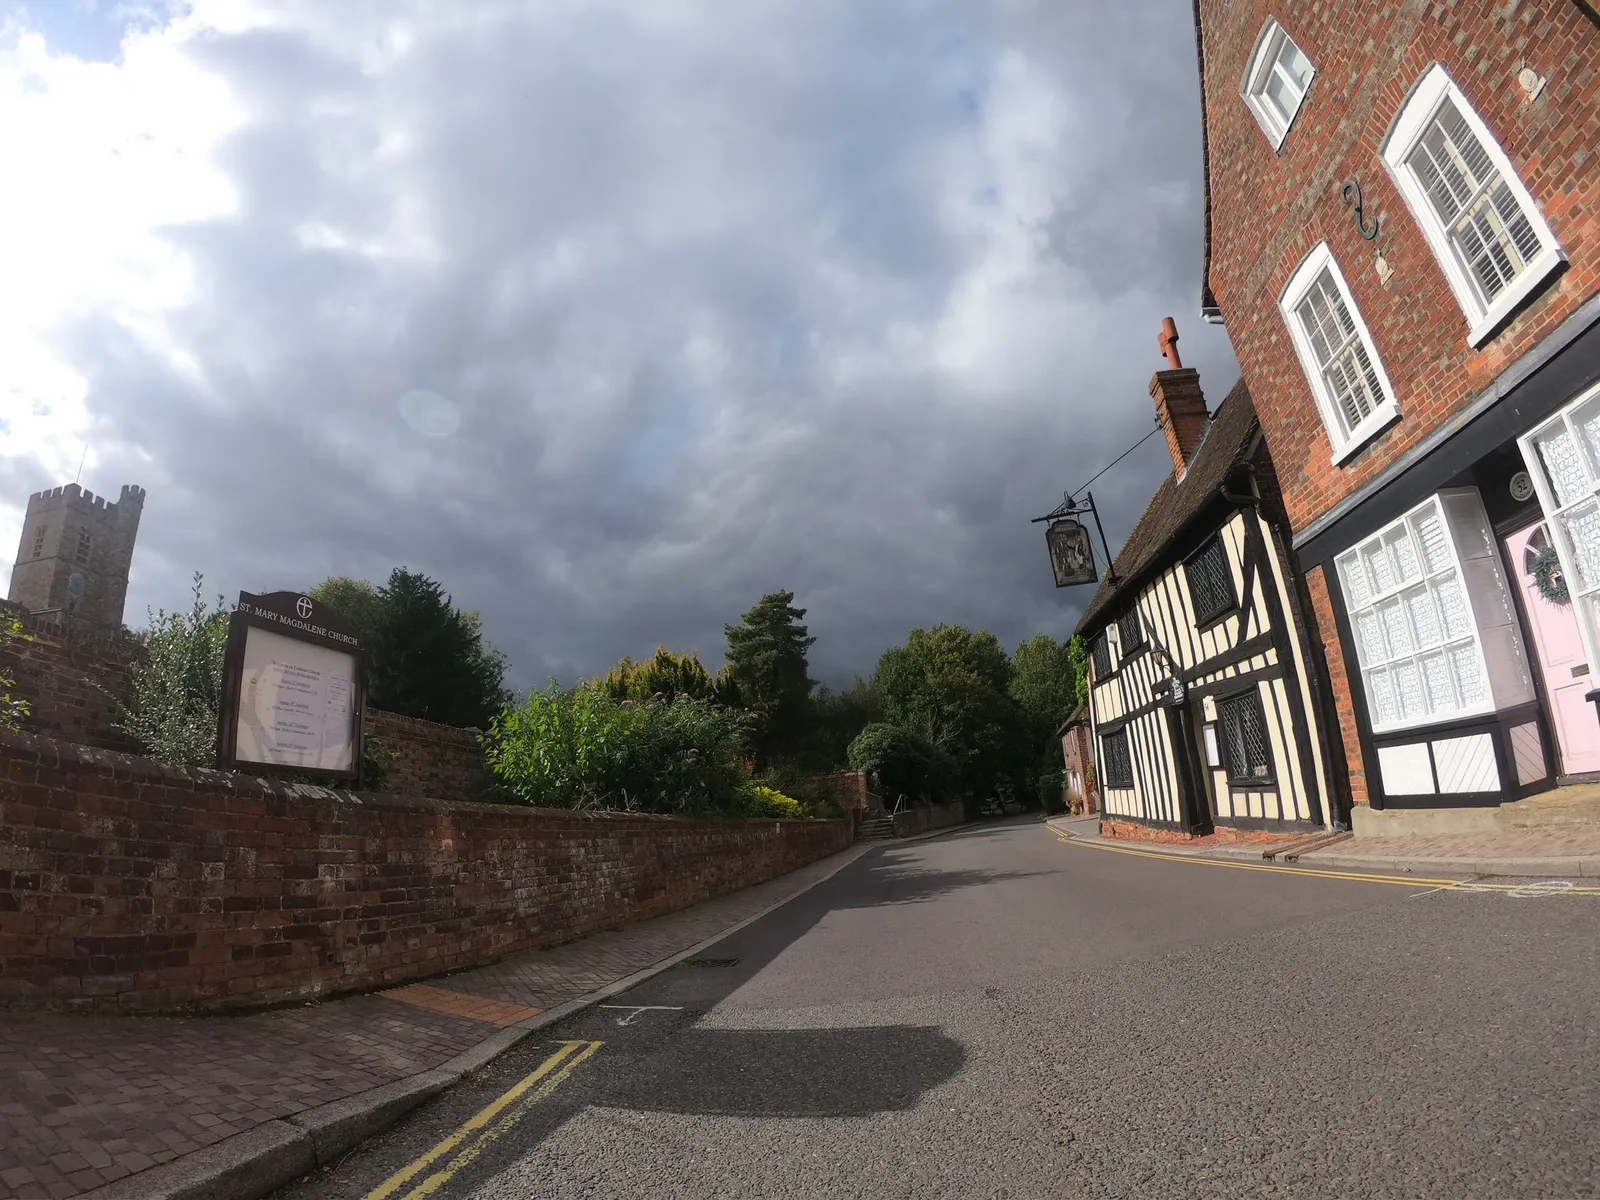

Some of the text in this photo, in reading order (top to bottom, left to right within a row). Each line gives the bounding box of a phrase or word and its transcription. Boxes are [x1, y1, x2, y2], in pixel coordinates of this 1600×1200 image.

[1516, 479, 1528, 493] 52
[239, 602, 358, 646] ST. MARY MAGDALENE CHURCH
